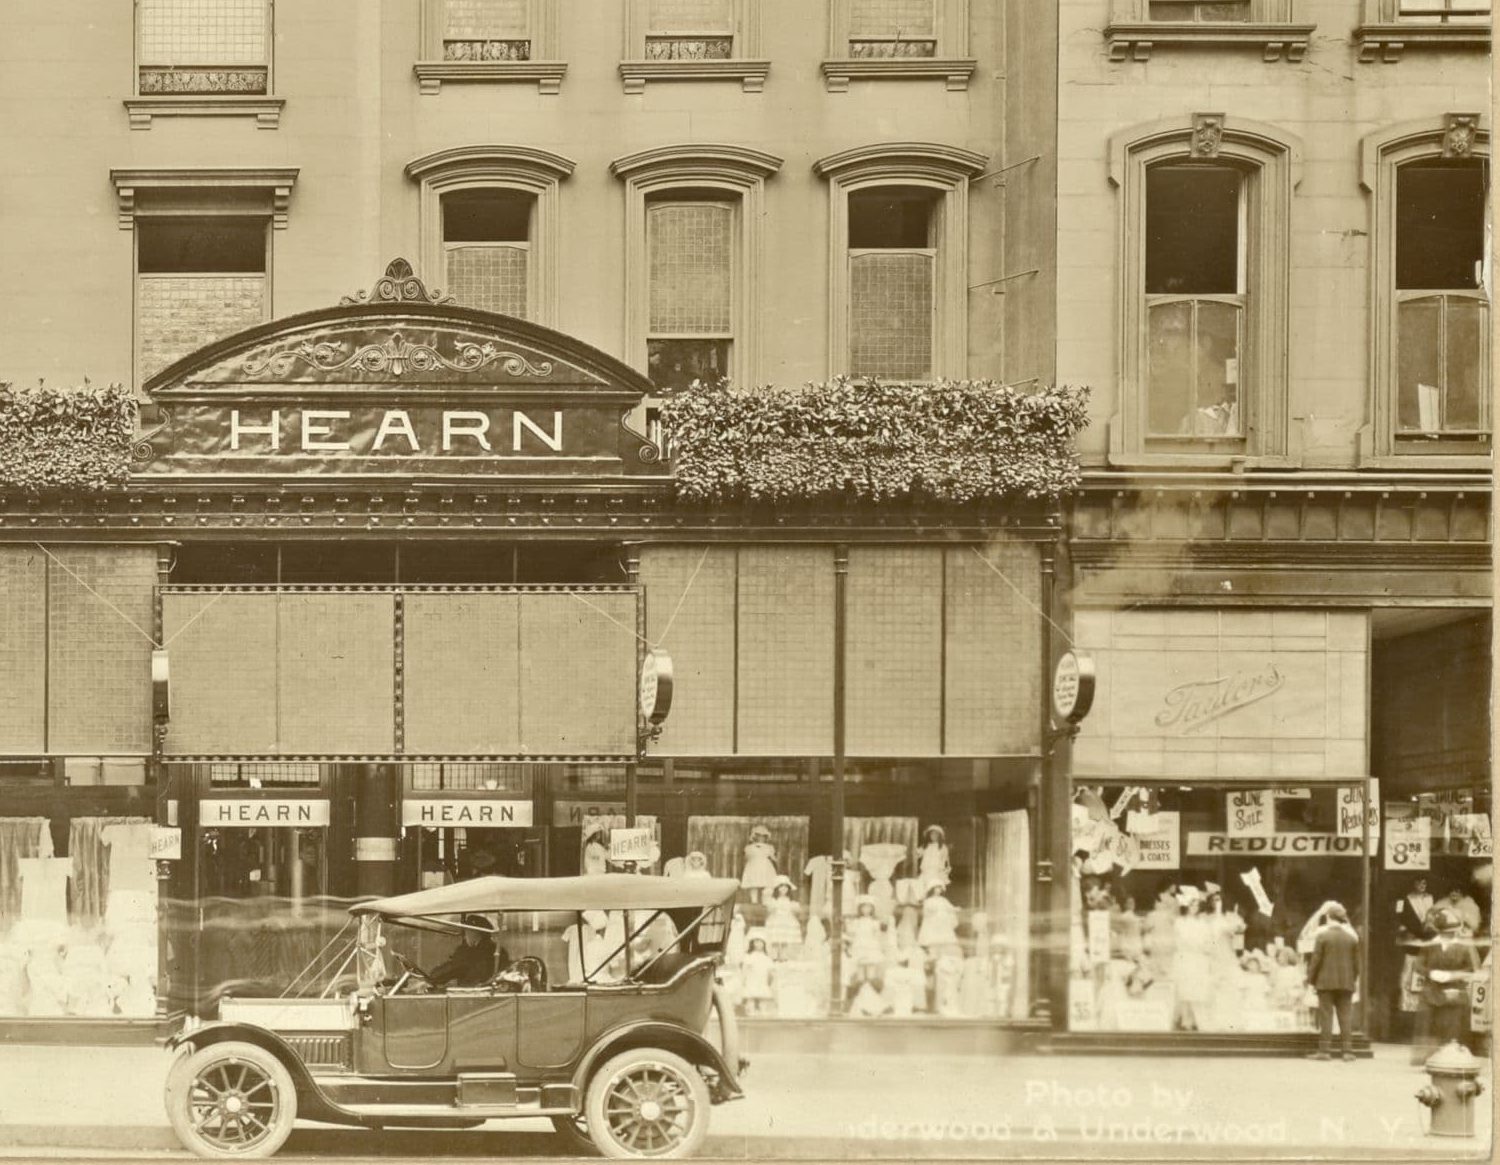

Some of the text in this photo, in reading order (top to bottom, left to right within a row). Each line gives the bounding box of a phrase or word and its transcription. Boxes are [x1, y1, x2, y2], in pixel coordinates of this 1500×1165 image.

[230, 410, 563, 452] HEARN
[219, 805, 311, 821] HEARN
[421, 805, 514, 821] HEARN
[151, 834, 180, 853] HEARN
[1207, 836, 1365, 852] REDUCTION
